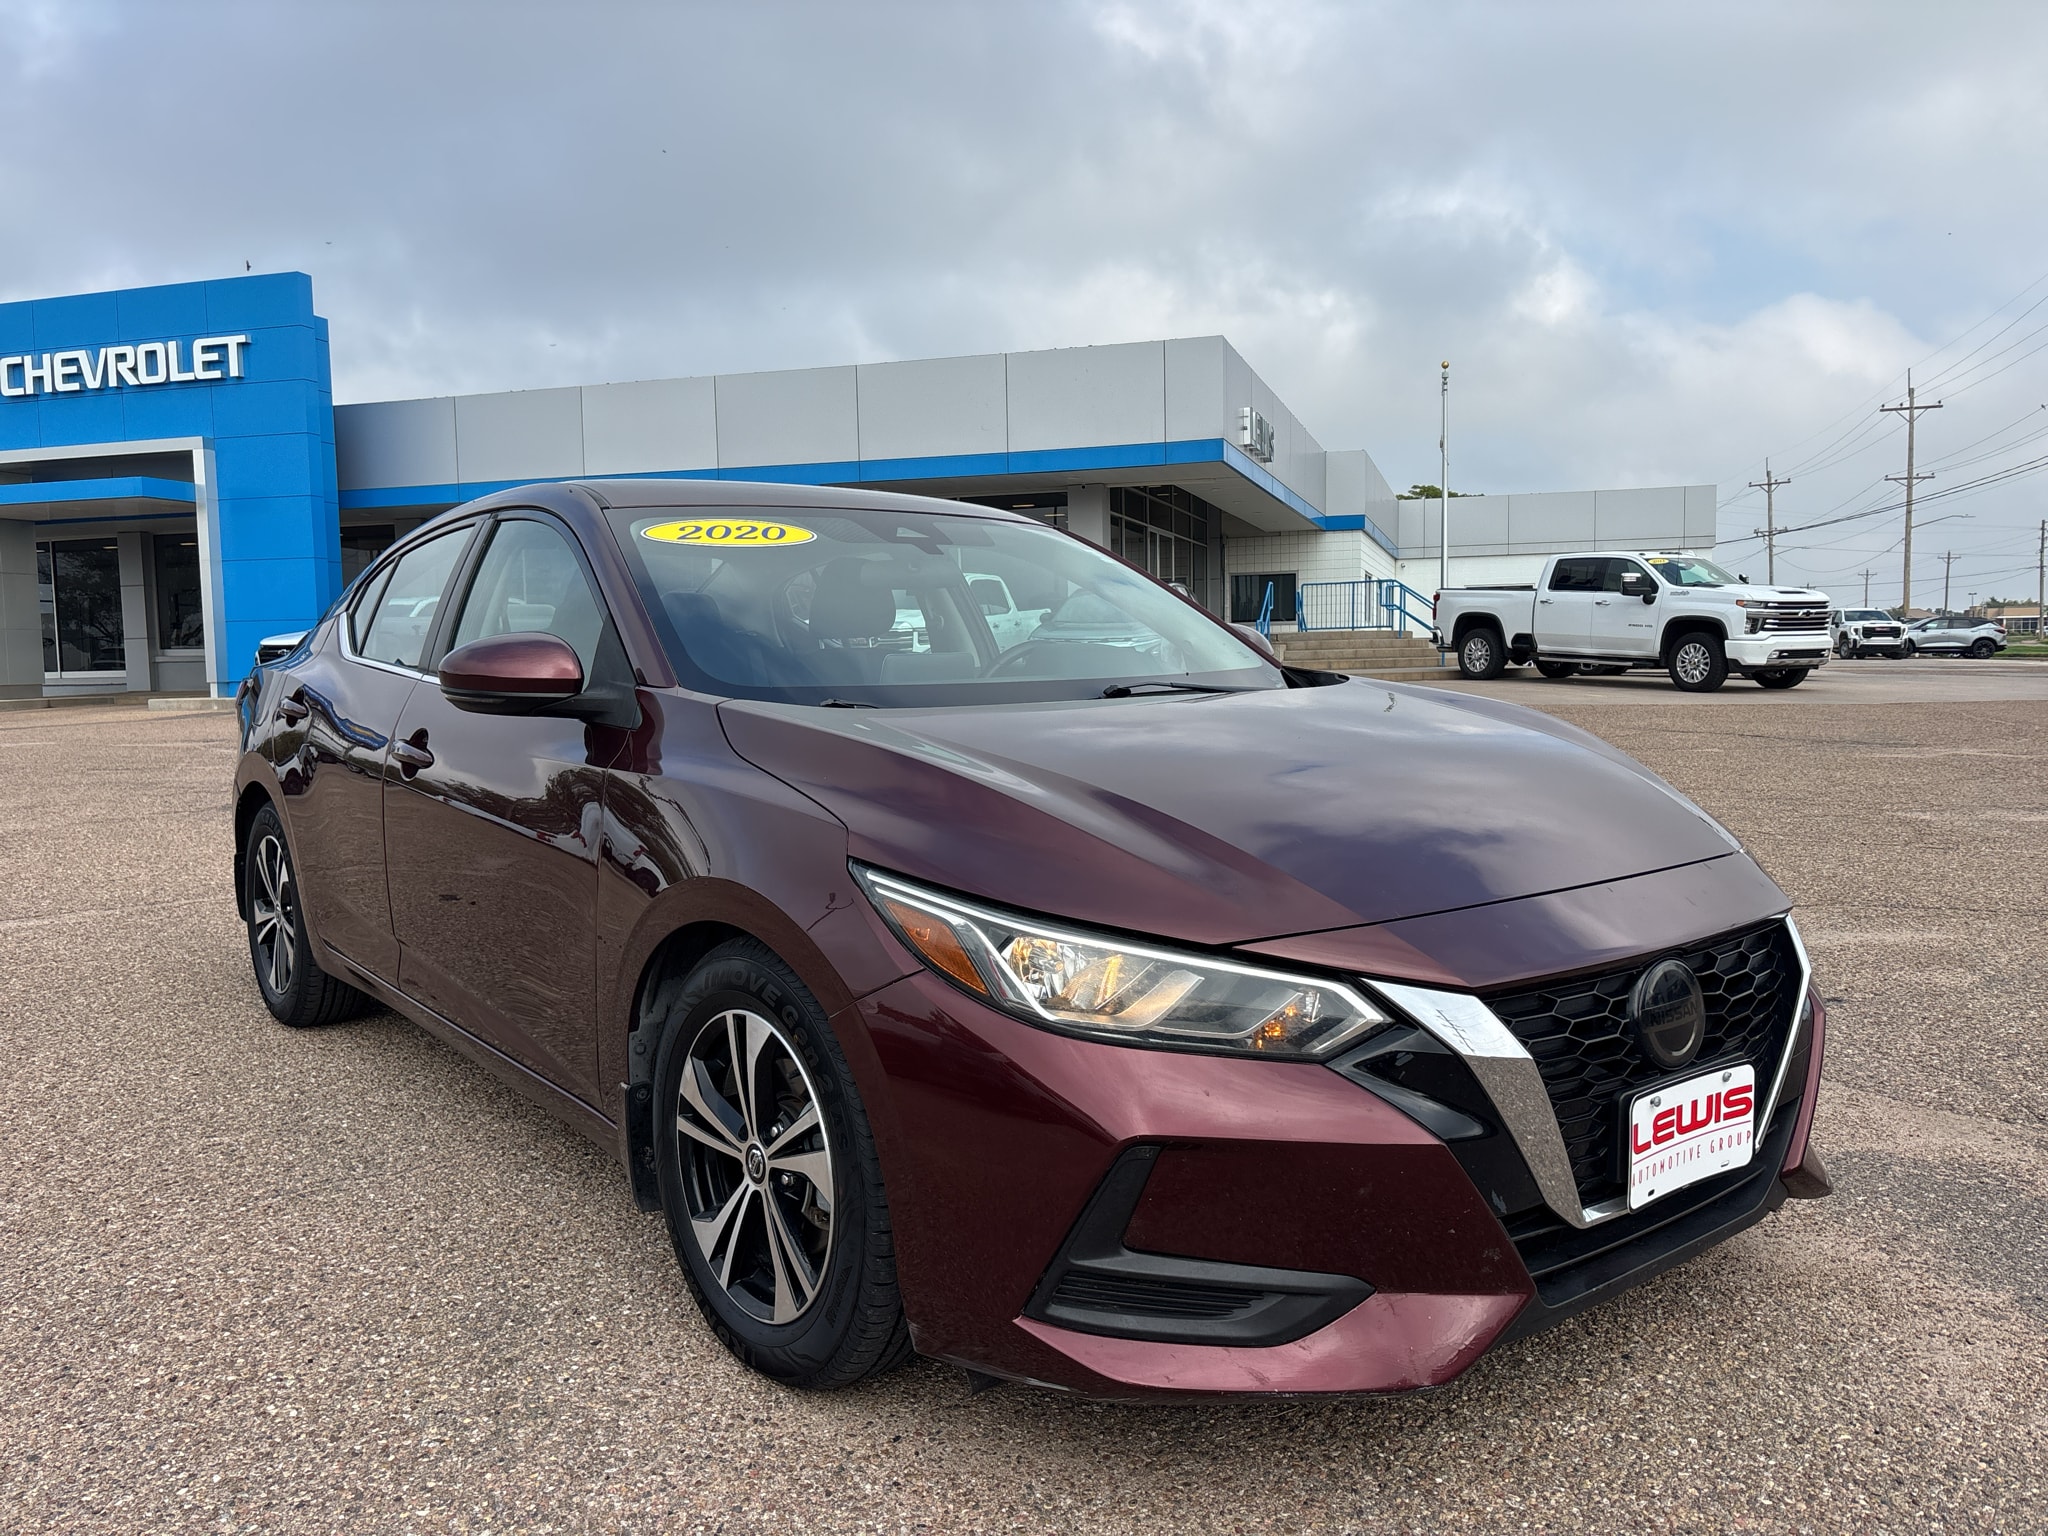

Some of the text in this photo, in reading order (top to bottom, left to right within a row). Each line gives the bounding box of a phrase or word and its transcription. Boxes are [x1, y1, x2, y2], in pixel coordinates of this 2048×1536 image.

[0, 334, 249, 397] CHEVROLET
[676, 524, 787, 541] 2020
[1632, 1084, 1753, 1155] LEWIS
[1632, 1130, 1752, 1188] AUTOMOTIVE GROUP
